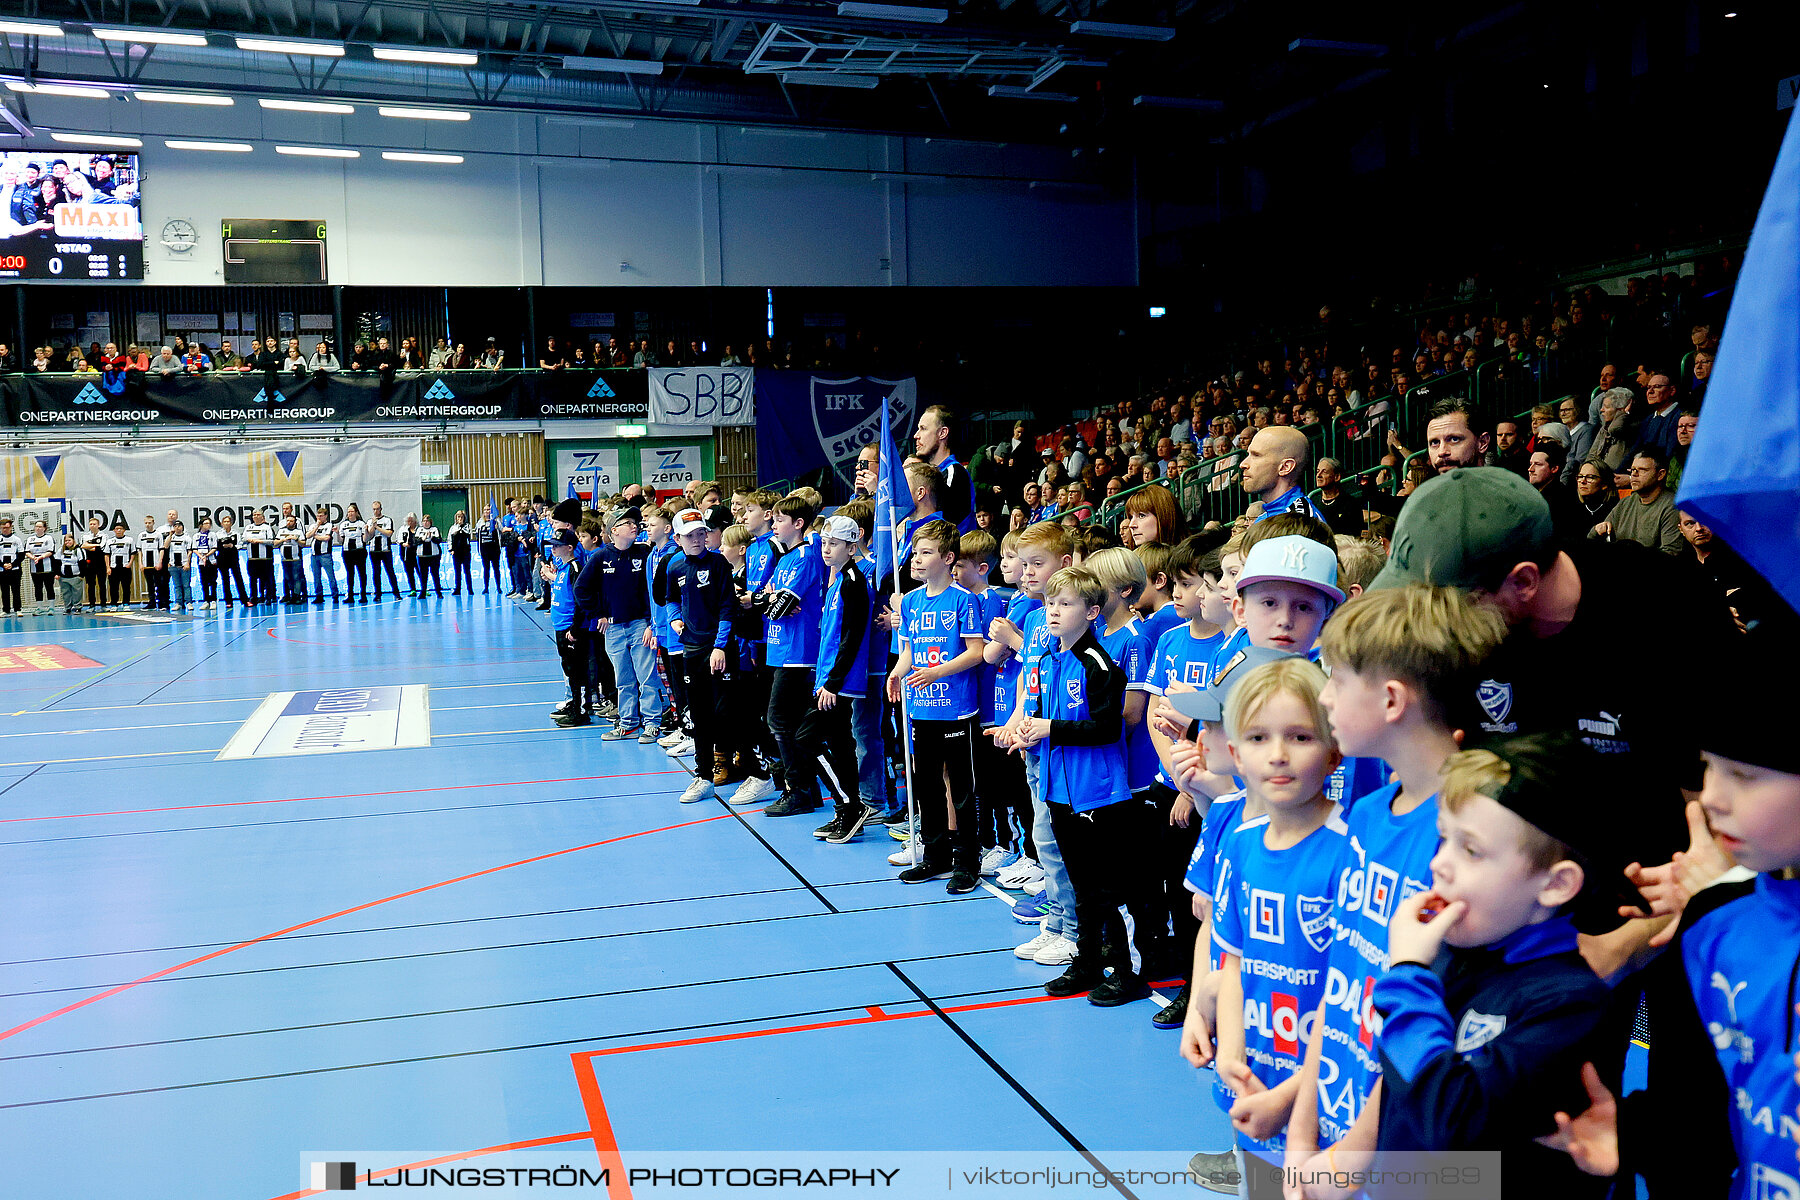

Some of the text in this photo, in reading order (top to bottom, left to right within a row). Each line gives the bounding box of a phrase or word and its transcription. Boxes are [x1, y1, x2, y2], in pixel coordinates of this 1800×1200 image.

[60, 206, 129, 227] MAXI
[223, 224, 326, 238] H G
[55, 243, 92, 254] YSTAD
[48, 257, 64, 275] 0
[663, 373, 743, 418] SBB
[825, 394, 864, 411] IFK
[20, 410, 159, 422] ONEPARTNERGROUP
[376, 405, 502, 417] ONEPARTNERGROUP
[651, 471, 693, 483] zerva
[1337, 866, 1365, 912] 69
